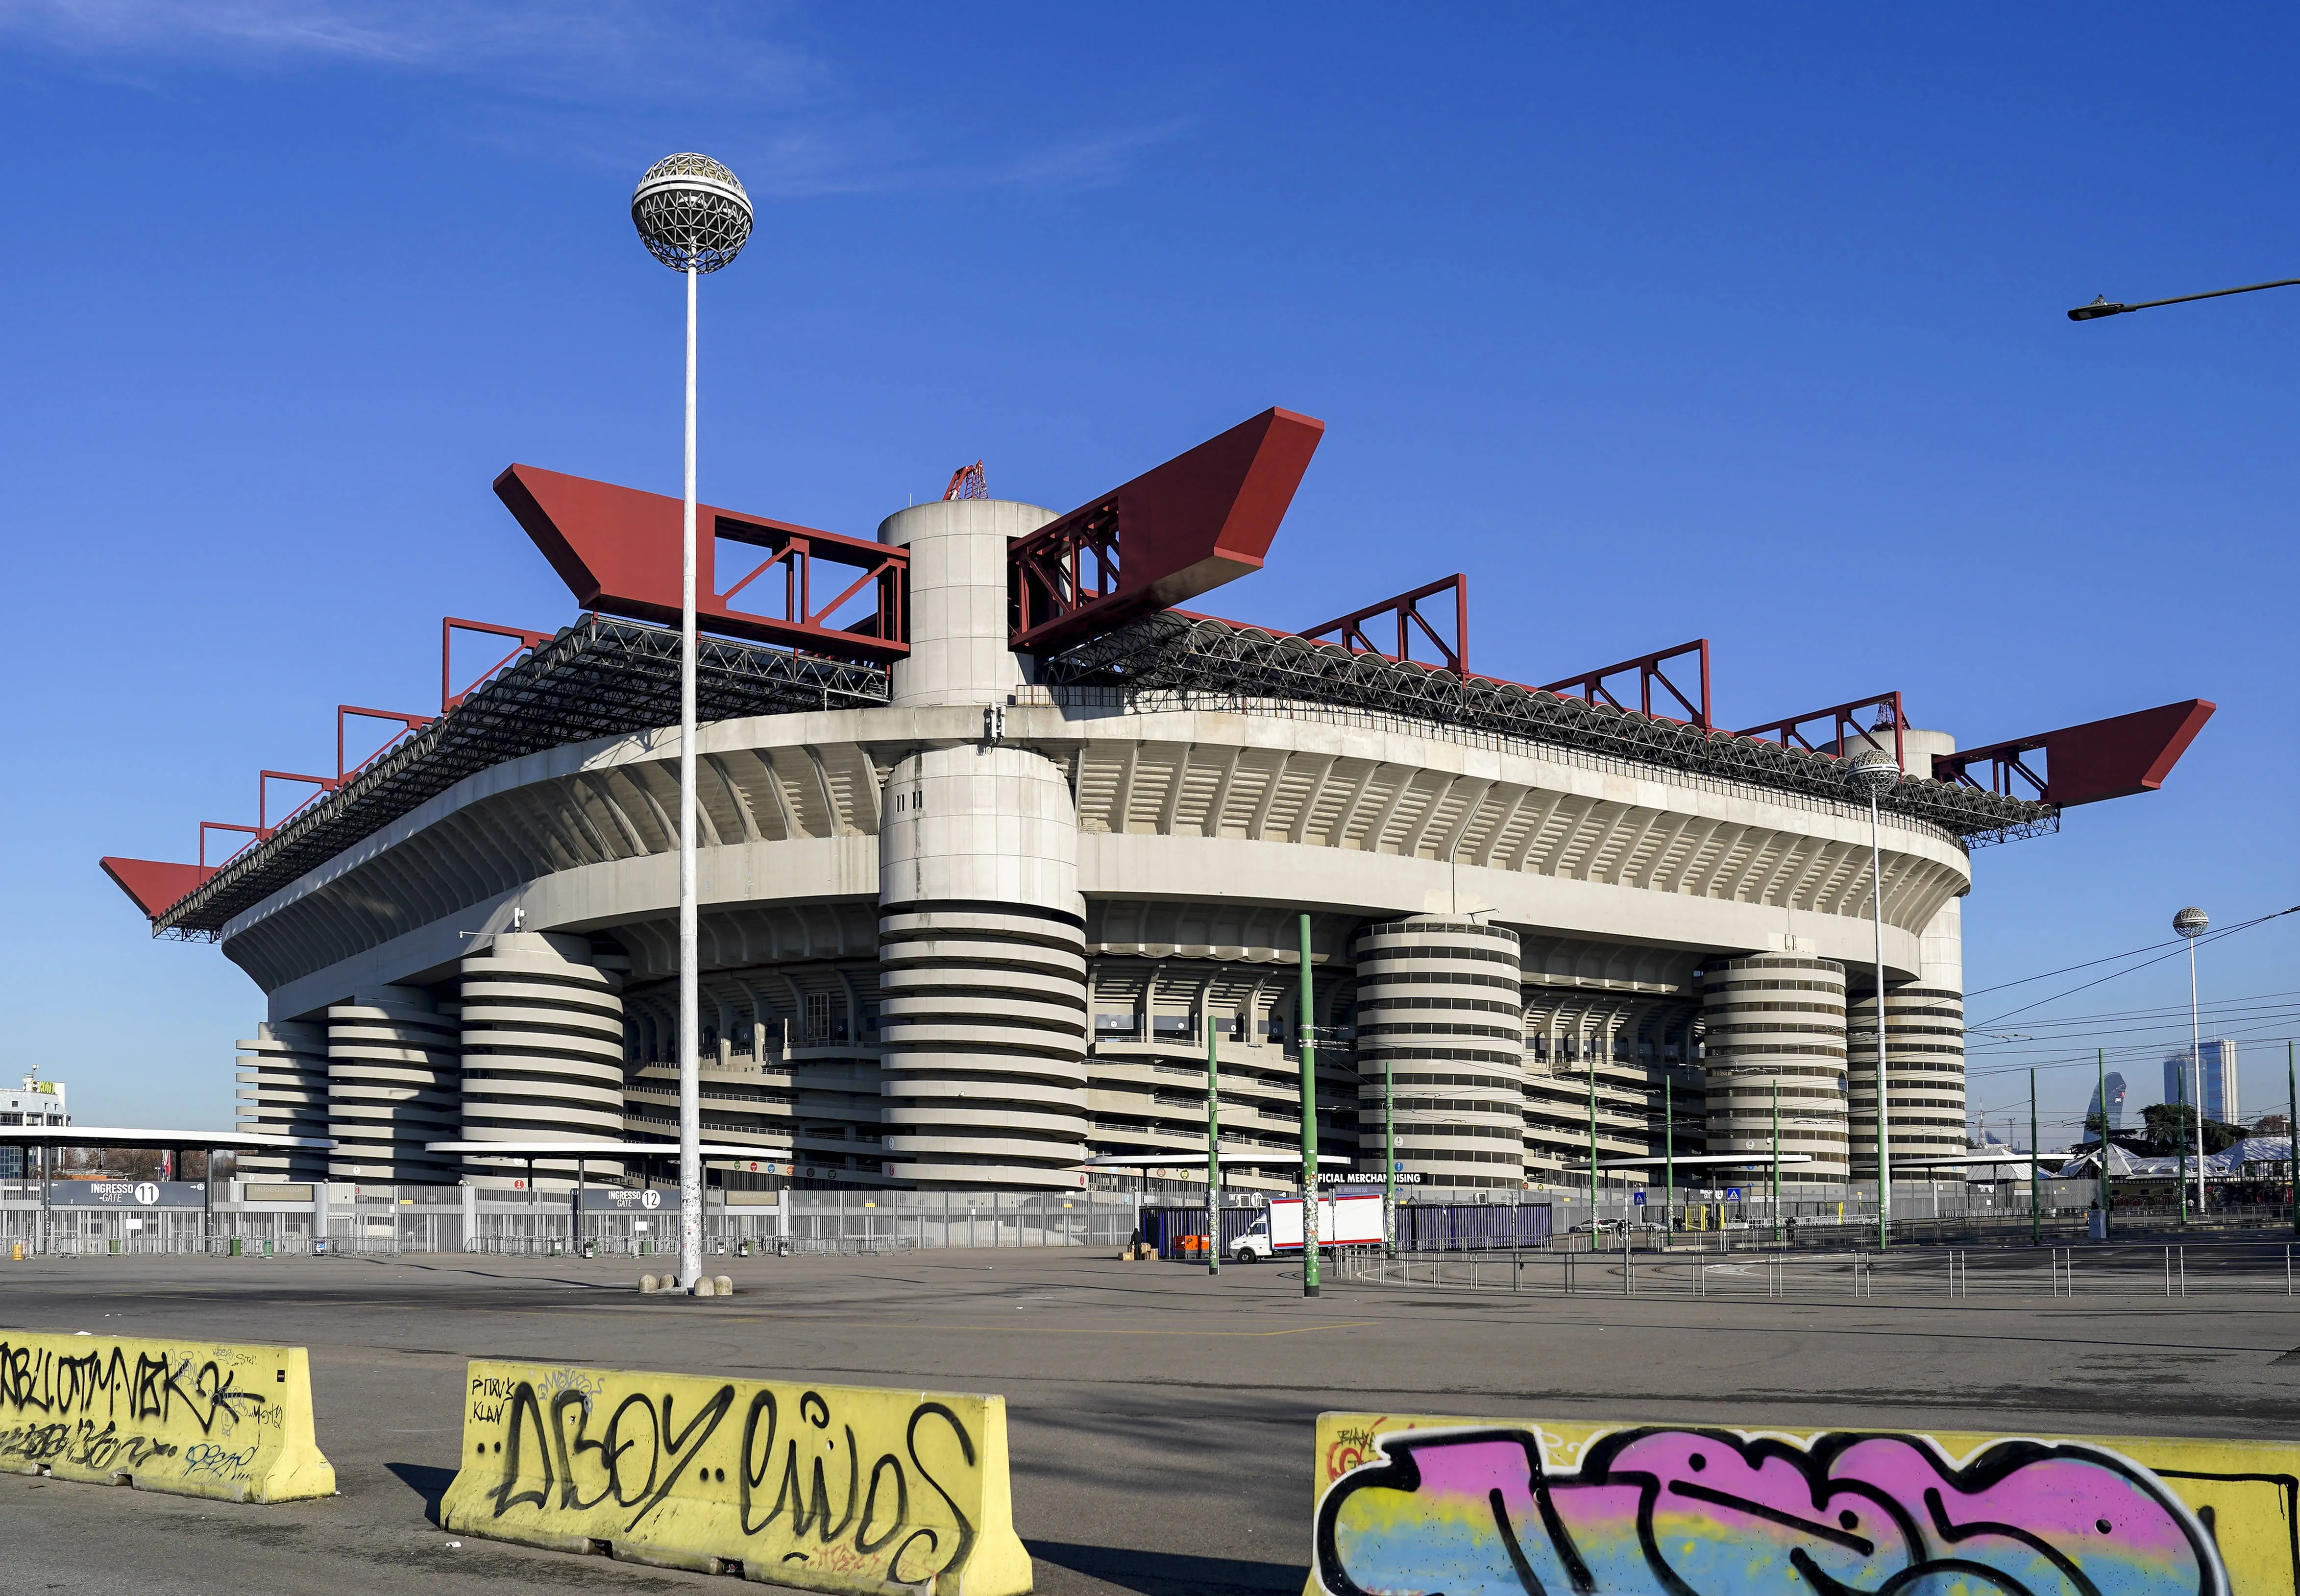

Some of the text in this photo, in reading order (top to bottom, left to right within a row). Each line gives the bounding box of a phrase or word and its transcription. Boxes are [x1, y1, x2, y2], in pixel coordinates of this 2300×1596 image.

[1318, 1173, 1345, 1183] FICIAL
[91, 1183, 153, 1201] INGRESSO 11
[608, 1191, 657, 1206] INGRESSO 12
